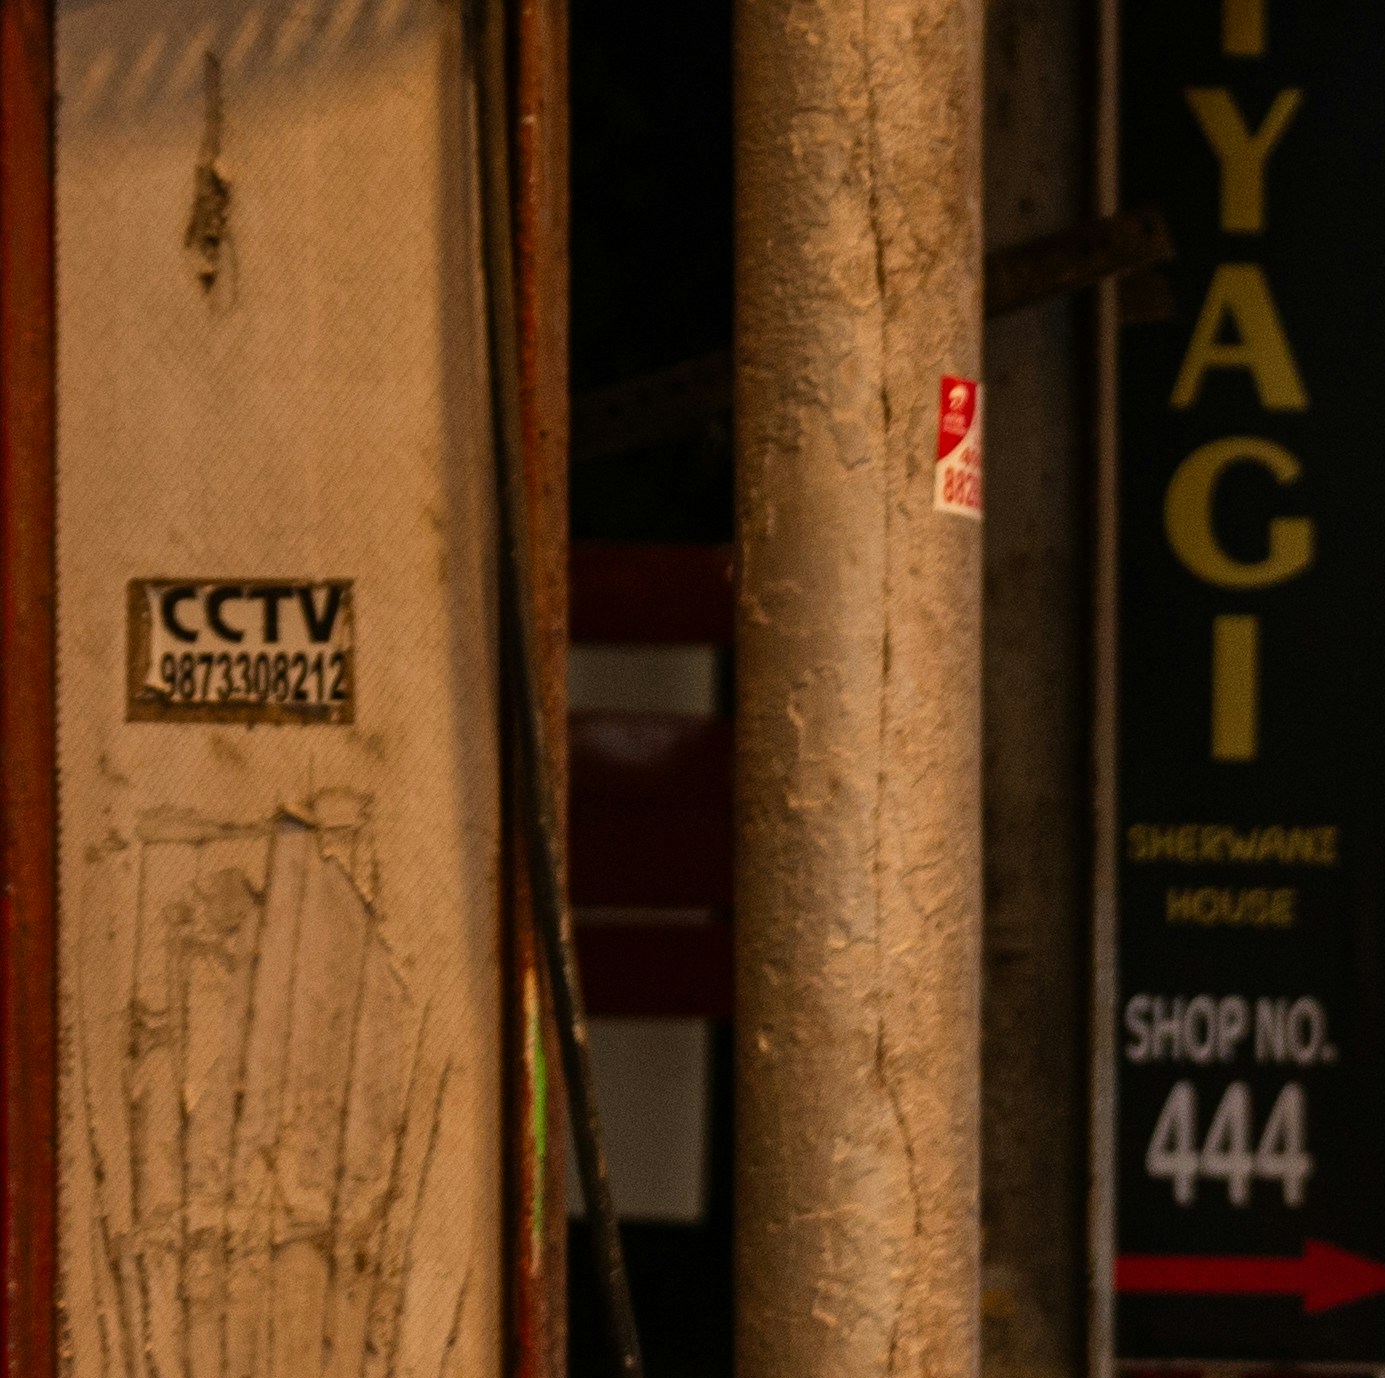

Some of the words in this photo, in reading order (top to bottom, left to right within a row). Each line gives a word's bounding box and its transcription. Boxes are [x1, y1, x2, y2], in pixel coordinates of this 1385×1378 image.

[161, 583, 345, 643] CCTV
[161, 651, 347, 702] 9873308212
[1164, 885, 1298, 929] HOUSE
[1123, 993, 1249, 1067] SHOP
[1253, 994, 1339, 1067] NO.
[1144, 1078, 1316, 1208] 444
